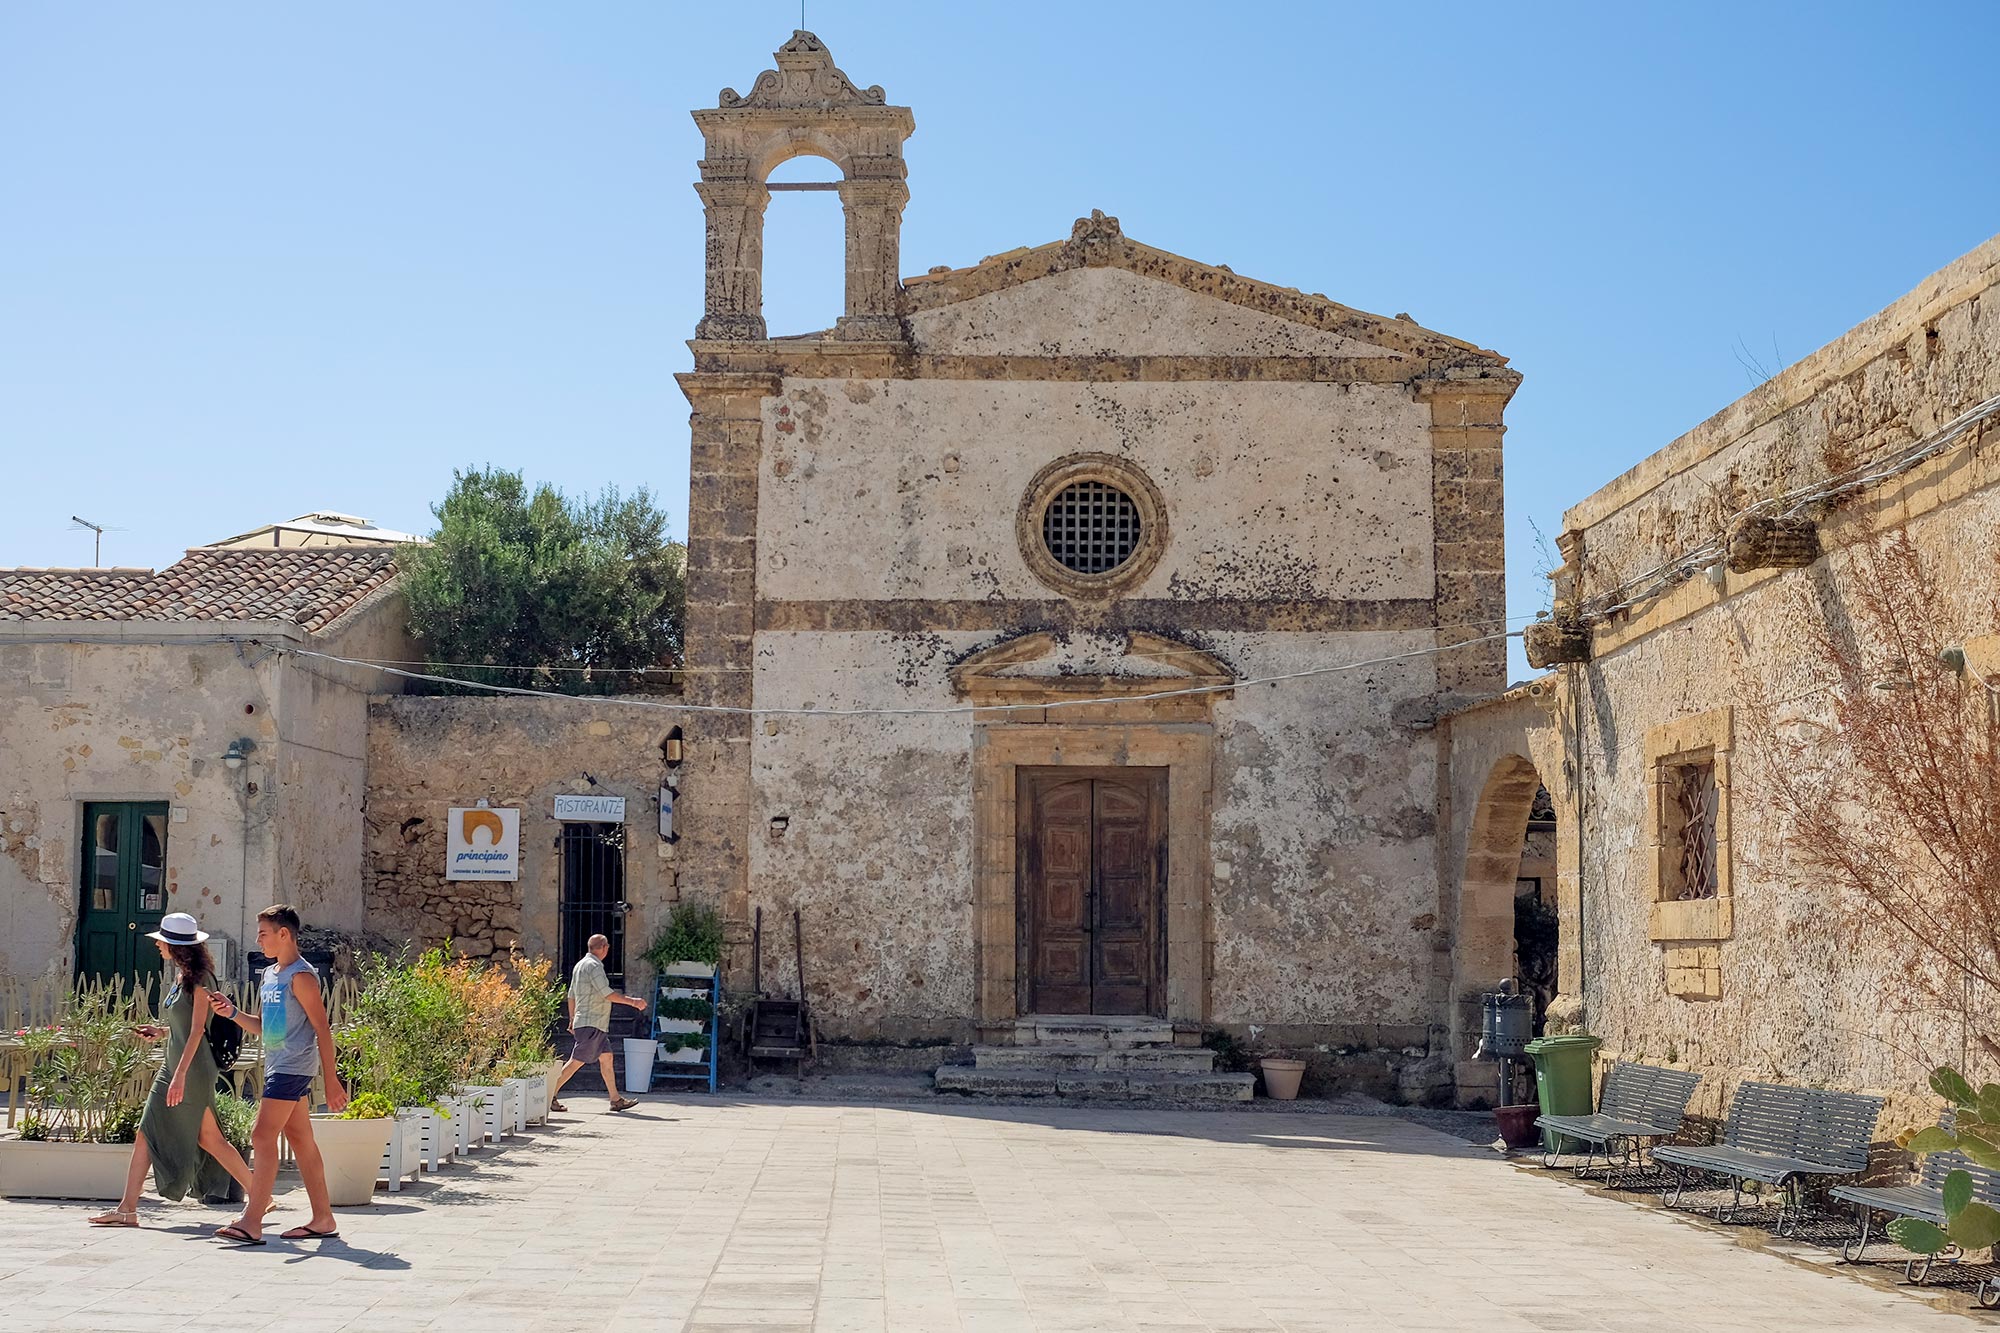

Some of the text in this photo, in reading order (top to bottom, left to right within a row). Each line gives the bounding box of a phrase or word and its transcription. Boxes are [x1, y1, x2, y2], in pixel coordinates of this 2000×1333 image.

[556, 799, 624, 814] RISTORANTE
[456, 849, 509, 863] principino
[261, 990, 281, 1003] ORE
